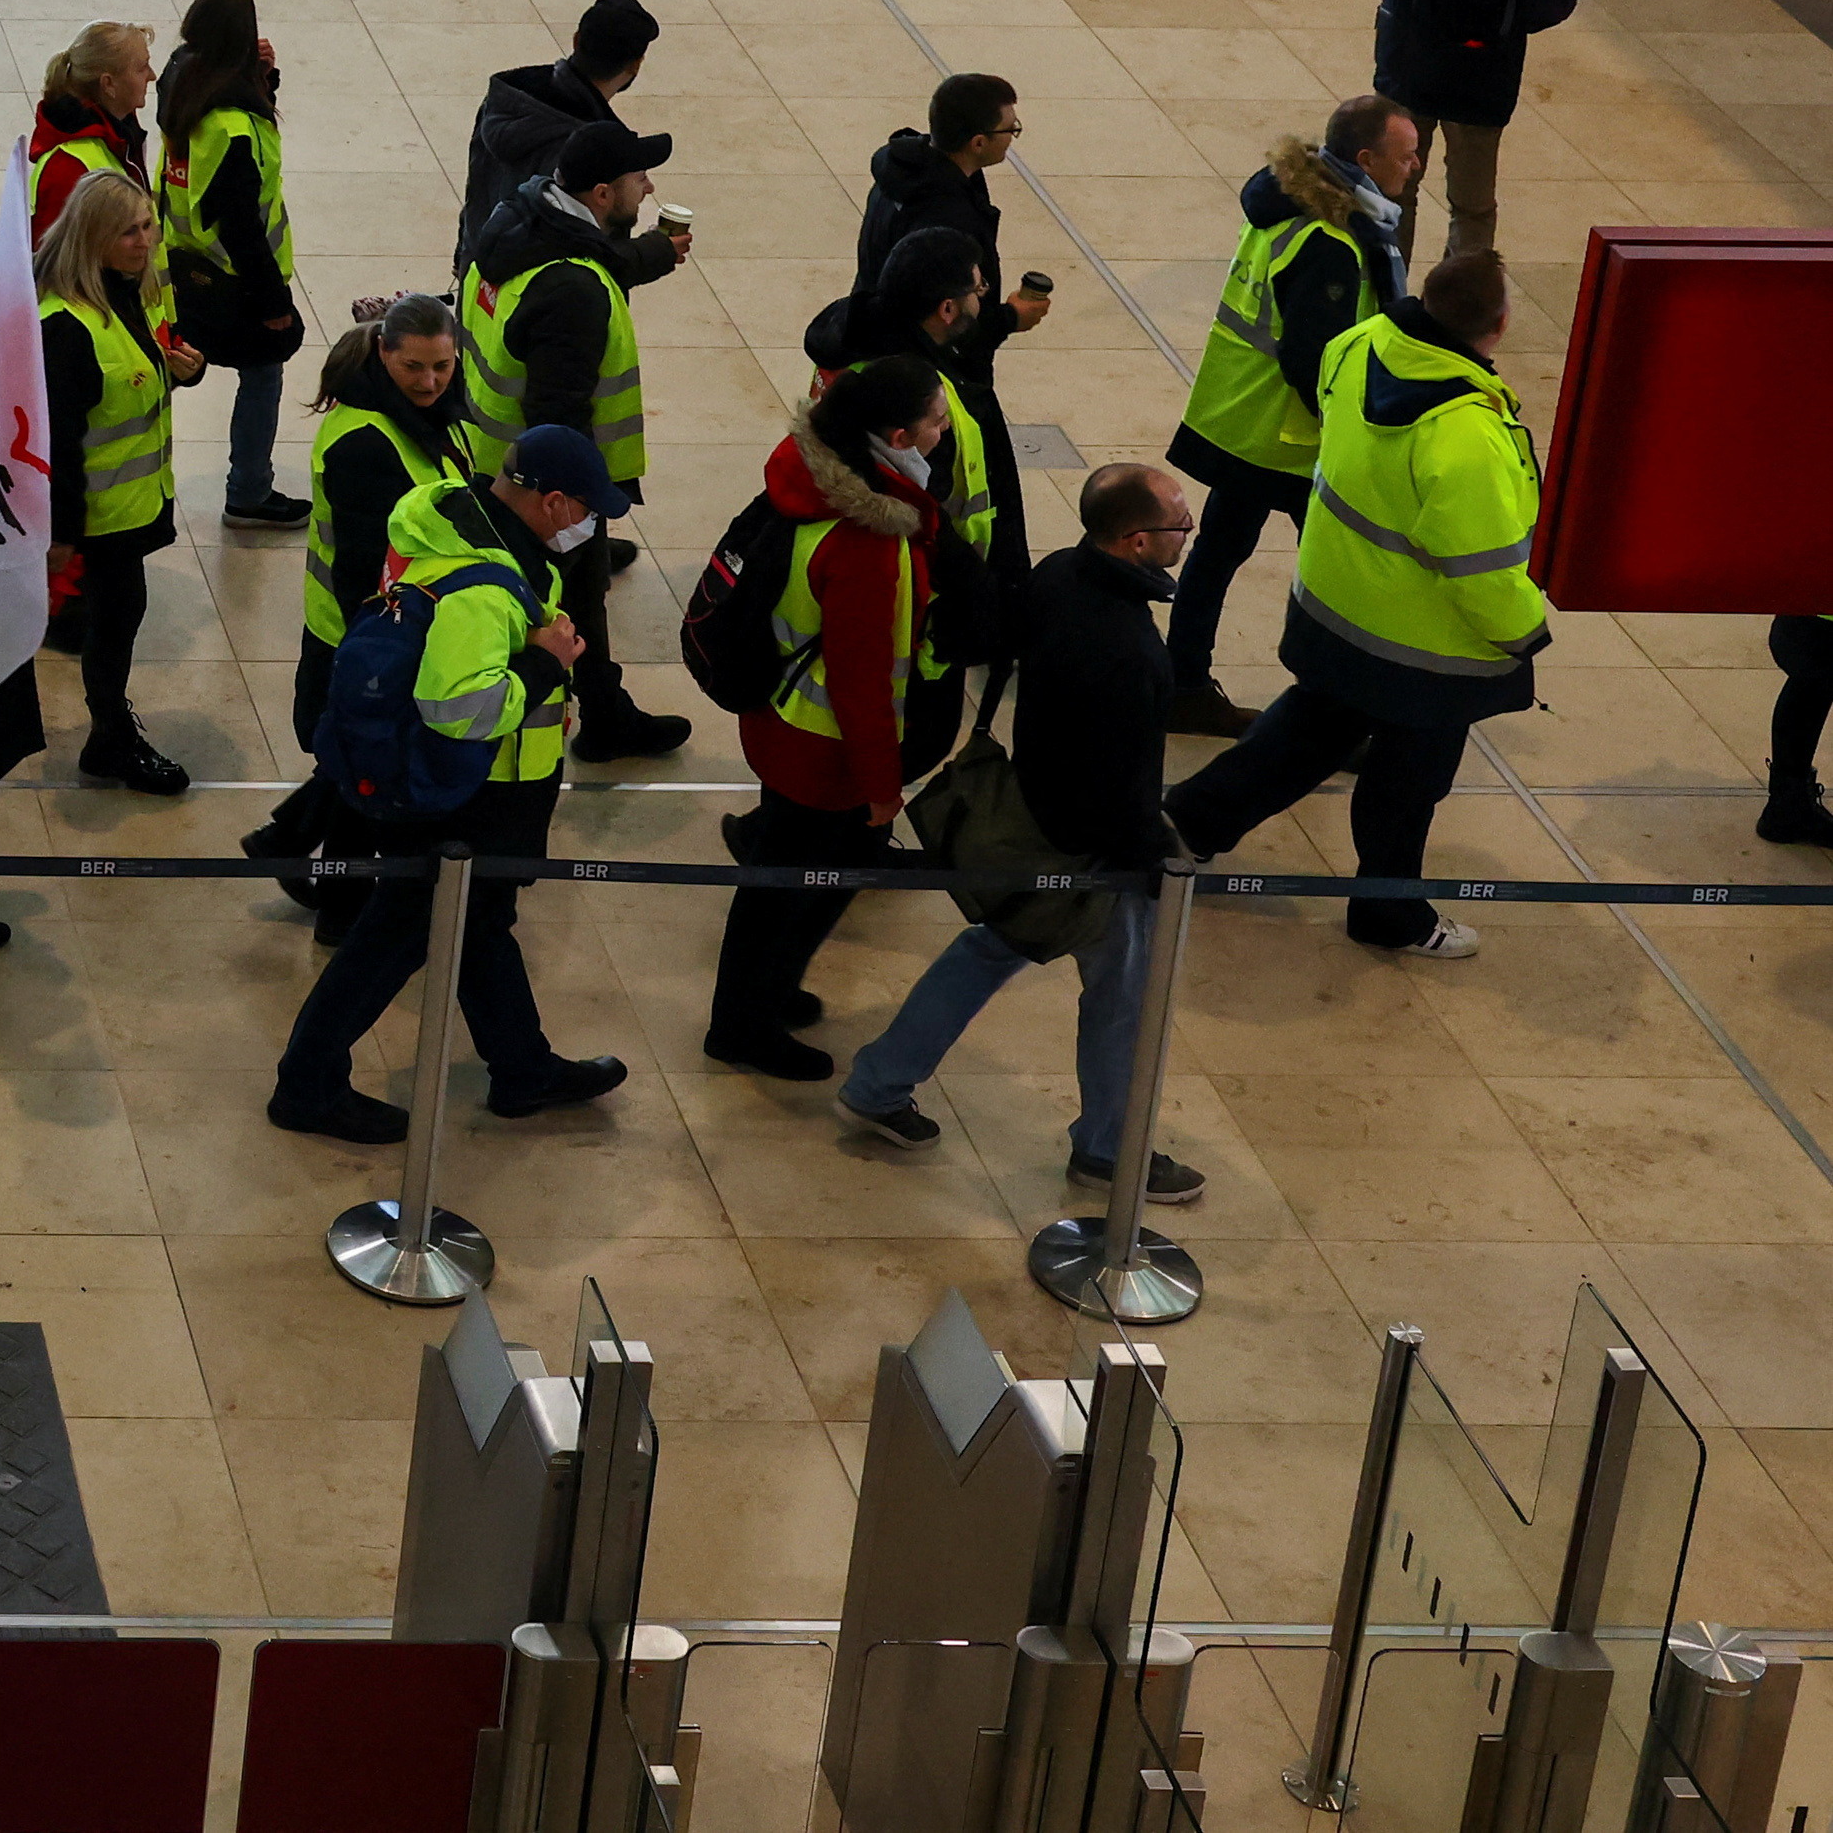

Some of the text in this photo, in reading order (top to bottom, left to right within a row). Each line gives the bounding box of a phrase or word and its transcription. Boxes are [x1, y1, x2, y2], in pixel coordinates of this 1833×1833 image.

[80, 861, 116, 875] BER
[312, 861, 347, 875] BER
[573, 863, 608, 878] BER
[804, 870, 840, 886] BER
[1036, 874, 1072, 889] BER
[1228, 877, 1263, 892] BER
[1459, 883, 1495, 898] BER
[1693, 888, 1729, 903] BER
